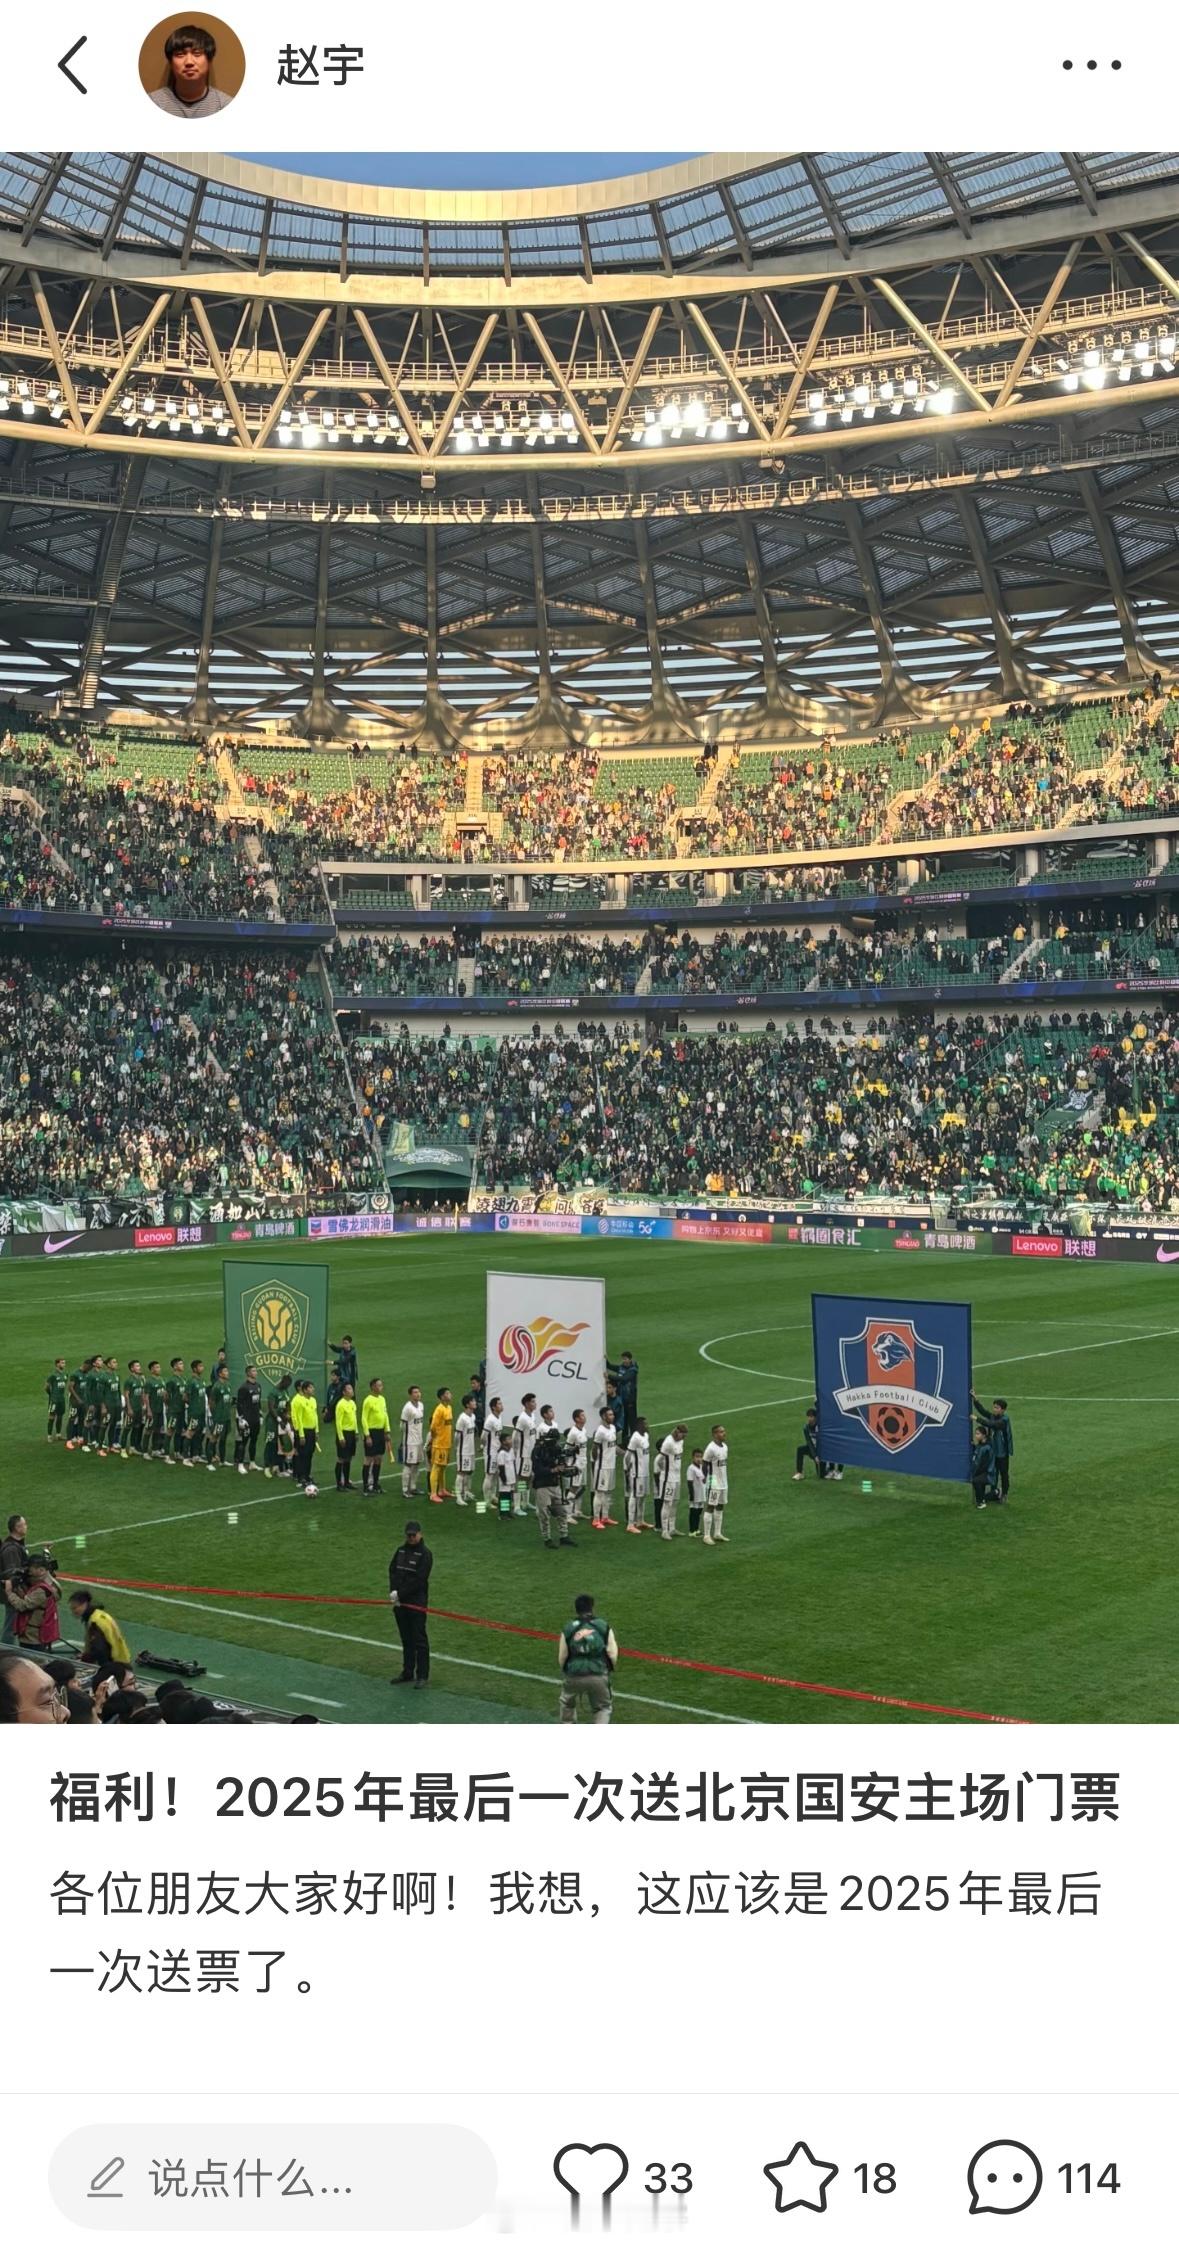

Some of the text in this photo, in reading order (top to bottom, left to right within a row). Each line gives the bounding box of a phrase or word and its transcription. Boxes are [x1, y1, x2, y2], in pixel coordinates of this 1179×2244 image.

[139, 1226, 202, 1242] Lenovo 联想
[639, 1221, 653, 1234] 5G
[924, 1233, 976, 1250] 青岛啤酒
[1016, 1239, 1097, 1256] Lenovo 联想
[250, 1291, 299, 1344] BEIJING GUOAN FOOTBALL CLUB
[256, 1354, 295, 1369] GUOAN
[547, 1359, 588, 1381] CSL
[846, 1391, 940, 1414] Hakka Football Club
[665, 1487, 674, 1496] 22
